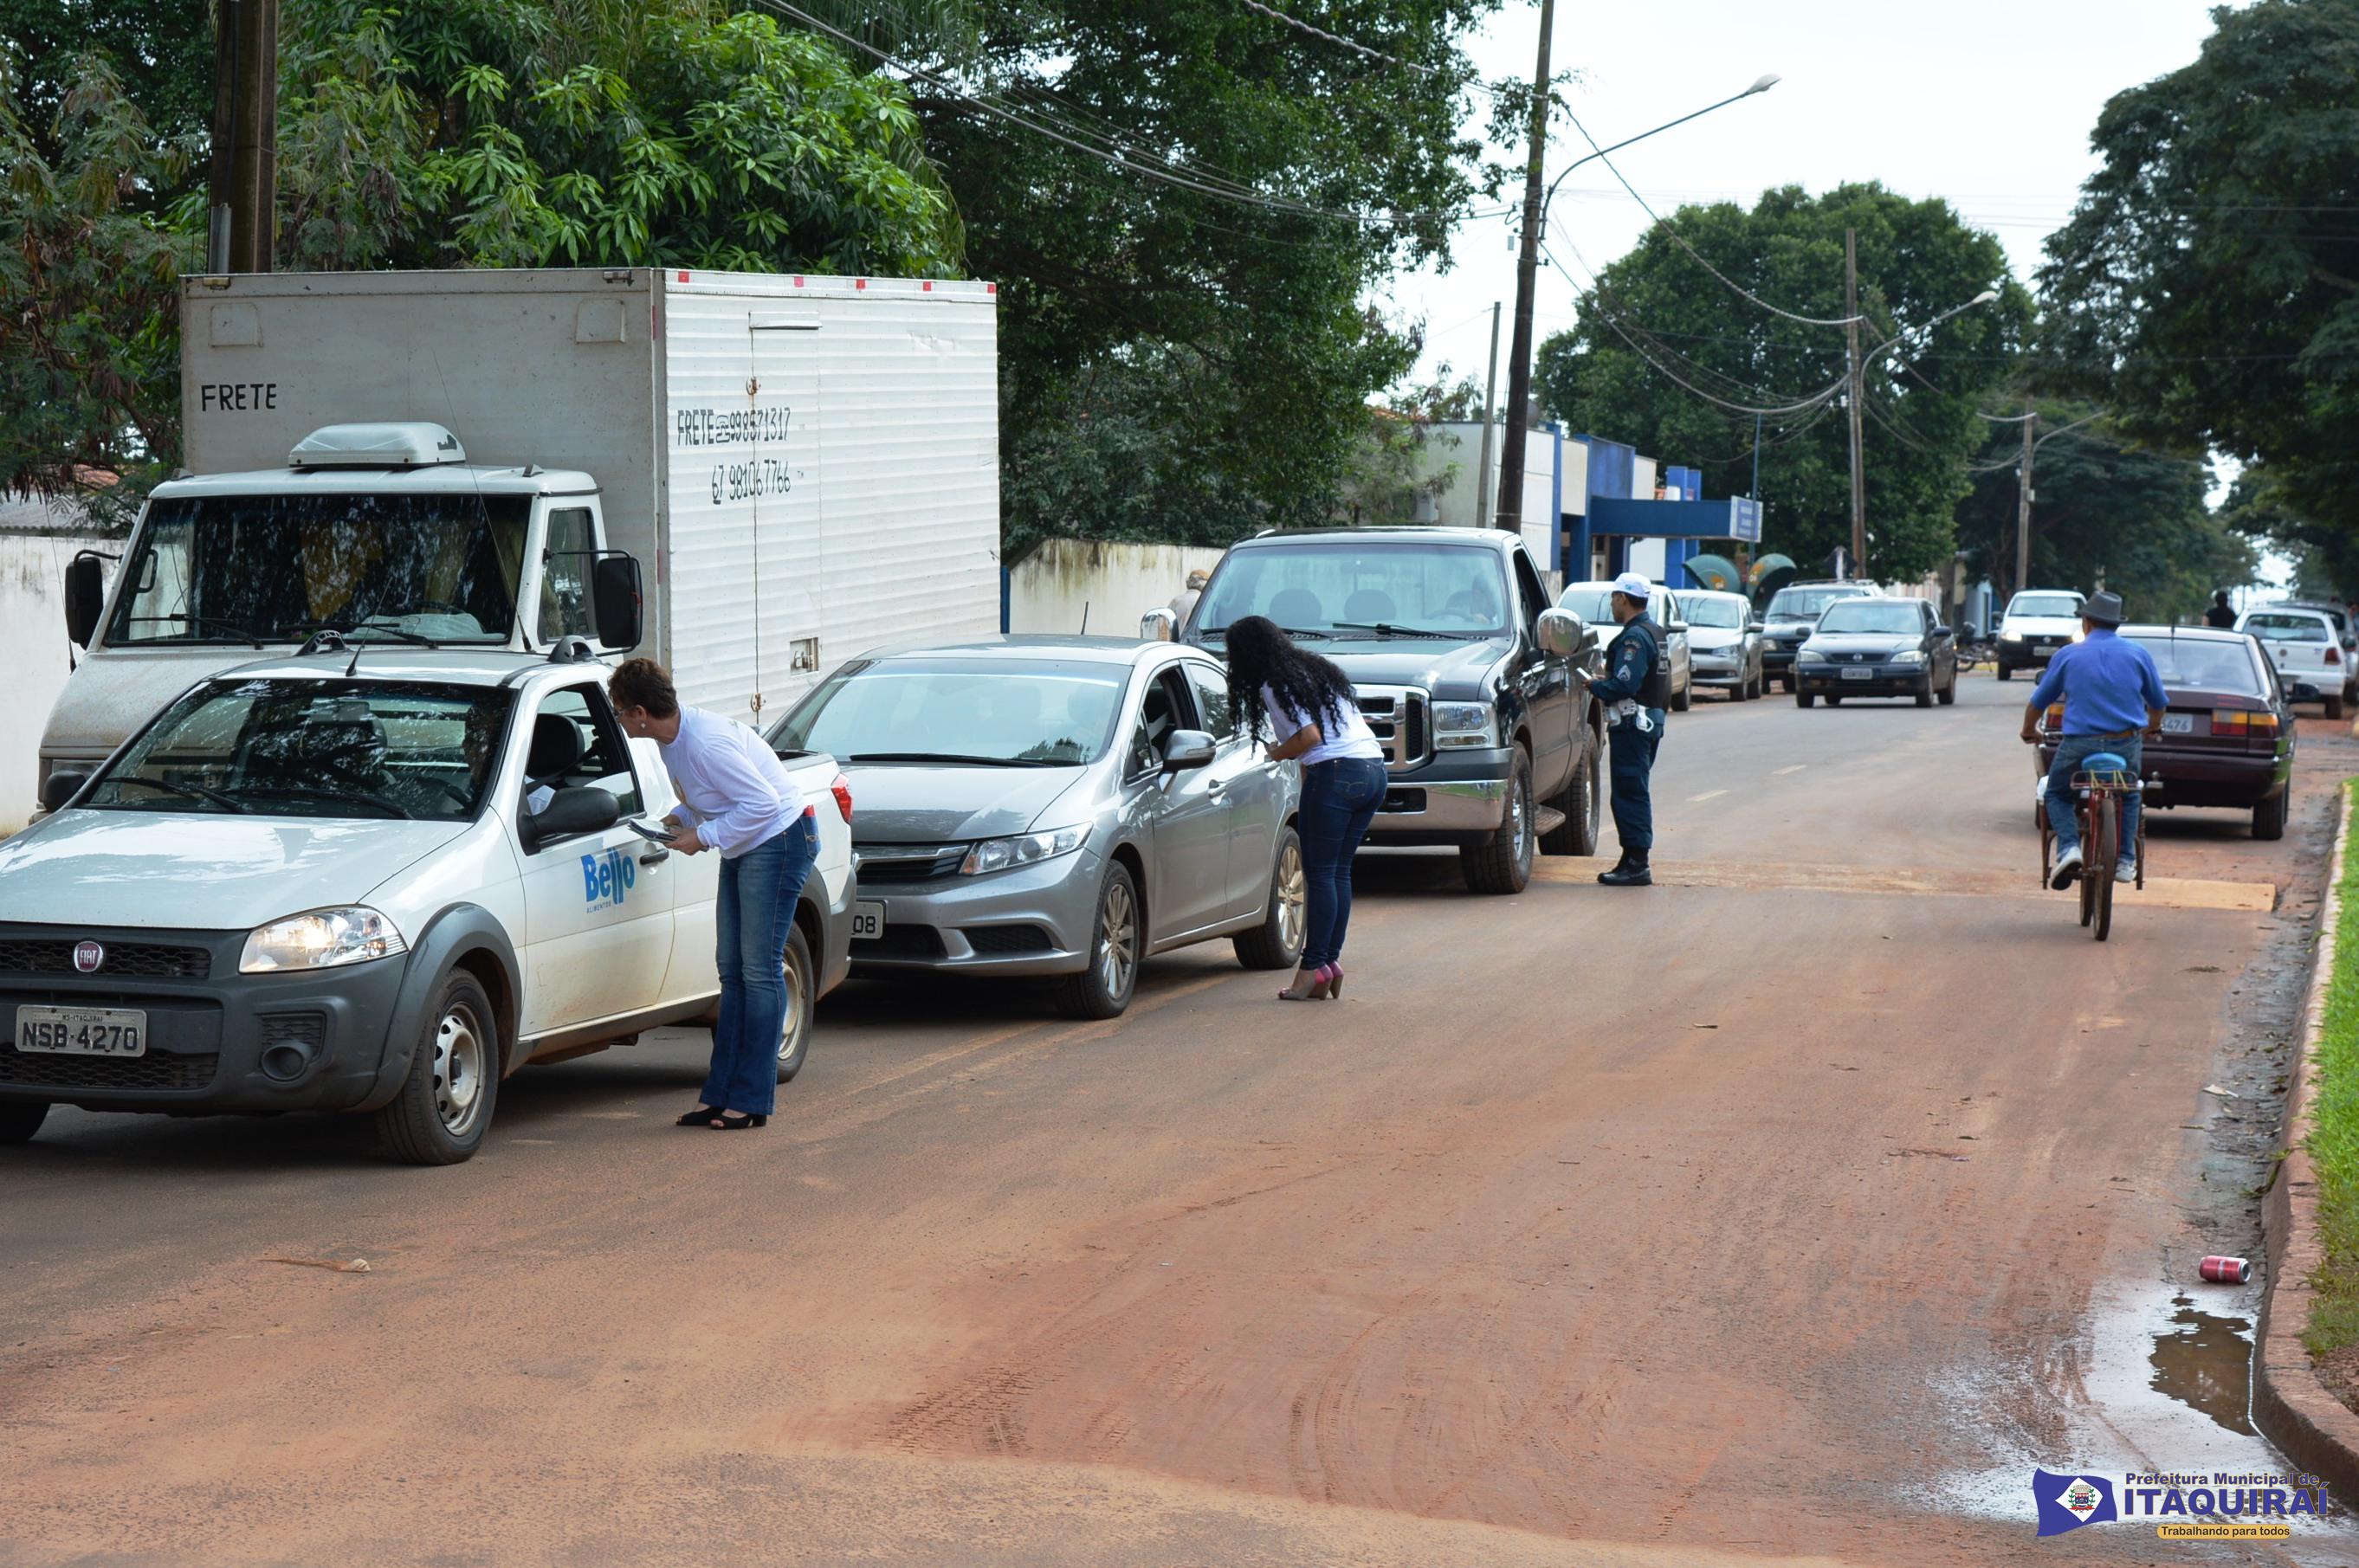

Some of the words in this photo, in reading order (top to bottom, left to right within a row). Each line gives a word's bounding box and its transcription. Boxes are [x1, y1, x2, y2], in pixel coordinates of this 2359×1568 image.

[201, 384, 277, 411] FRETE
[677, 409, 714, 446] FRETE
[712, 464, 725, 500] 67
[729, 459, 791, 500] 981067766
[580, 847, 635, 905] Bello
[80, 949, 98, 965] FIAT
